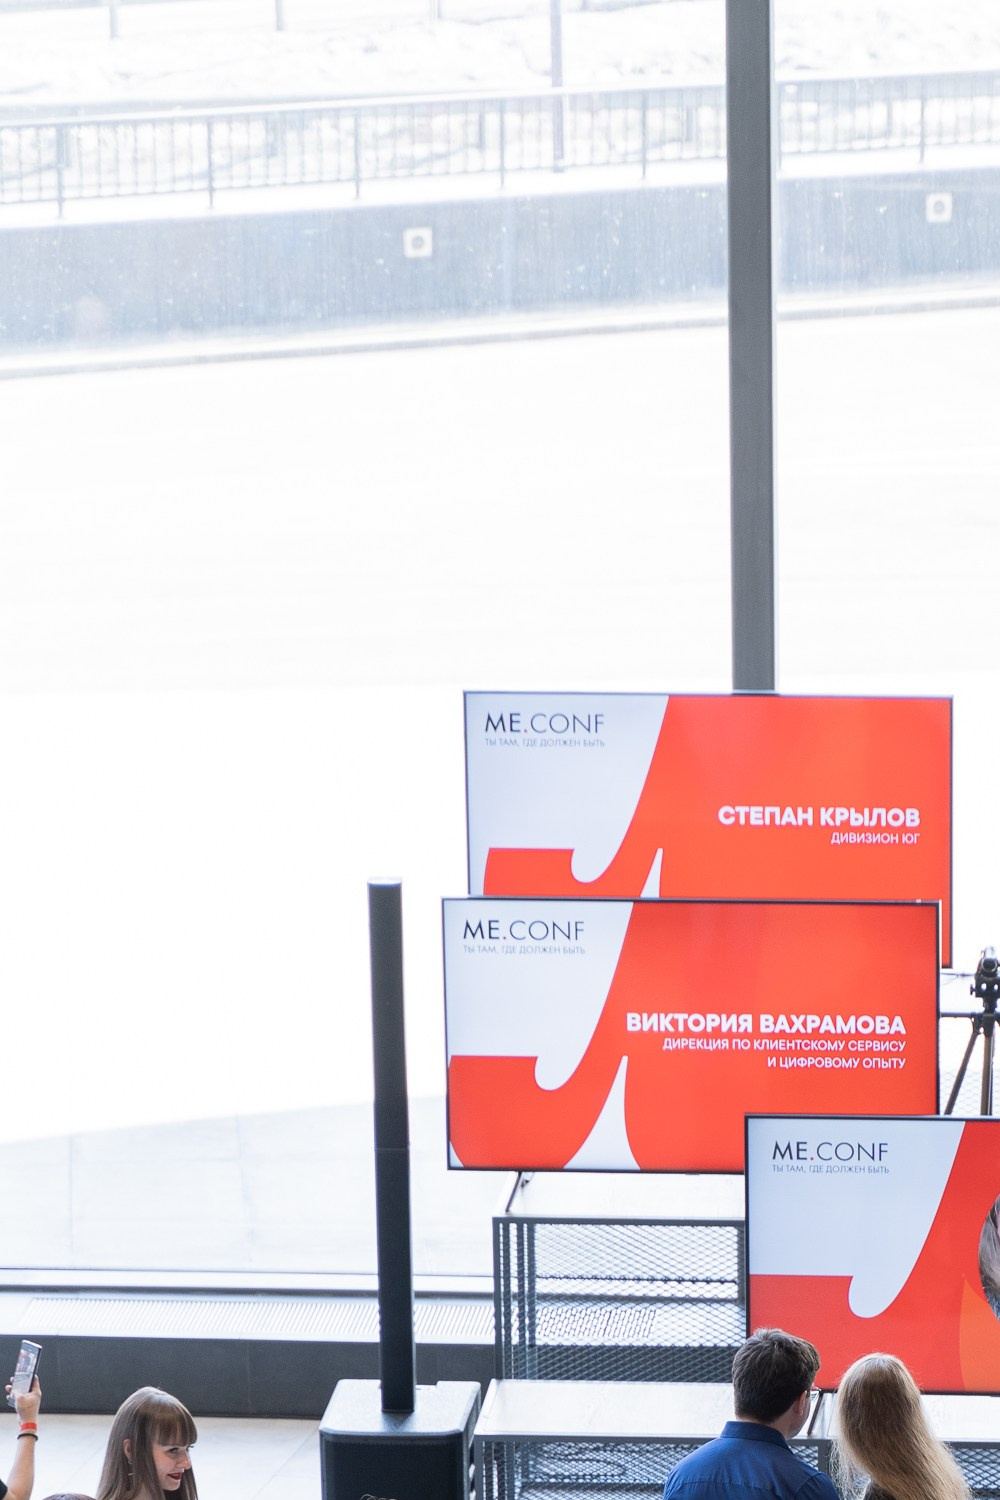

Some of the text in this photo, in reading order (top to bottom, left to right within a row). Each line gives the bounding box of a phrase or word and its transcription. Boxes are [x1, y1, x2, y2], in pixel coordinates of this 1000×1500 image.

[485, 713, 605, 734] ME.CONF
[485, 738, 496, 746] ТЫ
[522, 738, 537, 748] ГДЕ
[540, 739, 580, 748] ДОЛЖЕН
[583, 739, 605, 748] БЫТЬ
[718, 806, 920, 827] СТЕПАН КРЫЛОВ
[831, 832, 920, 845] ДИВИЗИОН ЮГ
[463, 919, 585, 941] ME.CONF
[463, 945, 475, 953] ТЫ
[502, 945, 517, 954] ГДЕ
[519, 945, 560, 954] ДОЛЖЕН
[563, 946, 586, 955] БЫТЬ
[626, 1012, 907, 1035] ВИКТОРИЯ ВАХРАМОВА
[663, 1038, 906, 1052] ДИРЕКЦИЯ ПО КЛИЕНТСКОМУ СЕРВИСУ
[767, 1057, 906, 1070] И ЦИФРОВОМУ ОПЫТУ
[772, 1140, 888, 1162] ME.CONF
[772, 1164, 783, 1172] ТЫ
[809, 1165, 823, 1174] ГДЕ
[826, 1165, 865, 1174] ДОЛЖЕН
[868, 1165, 890, 1174] БЫТЬ
